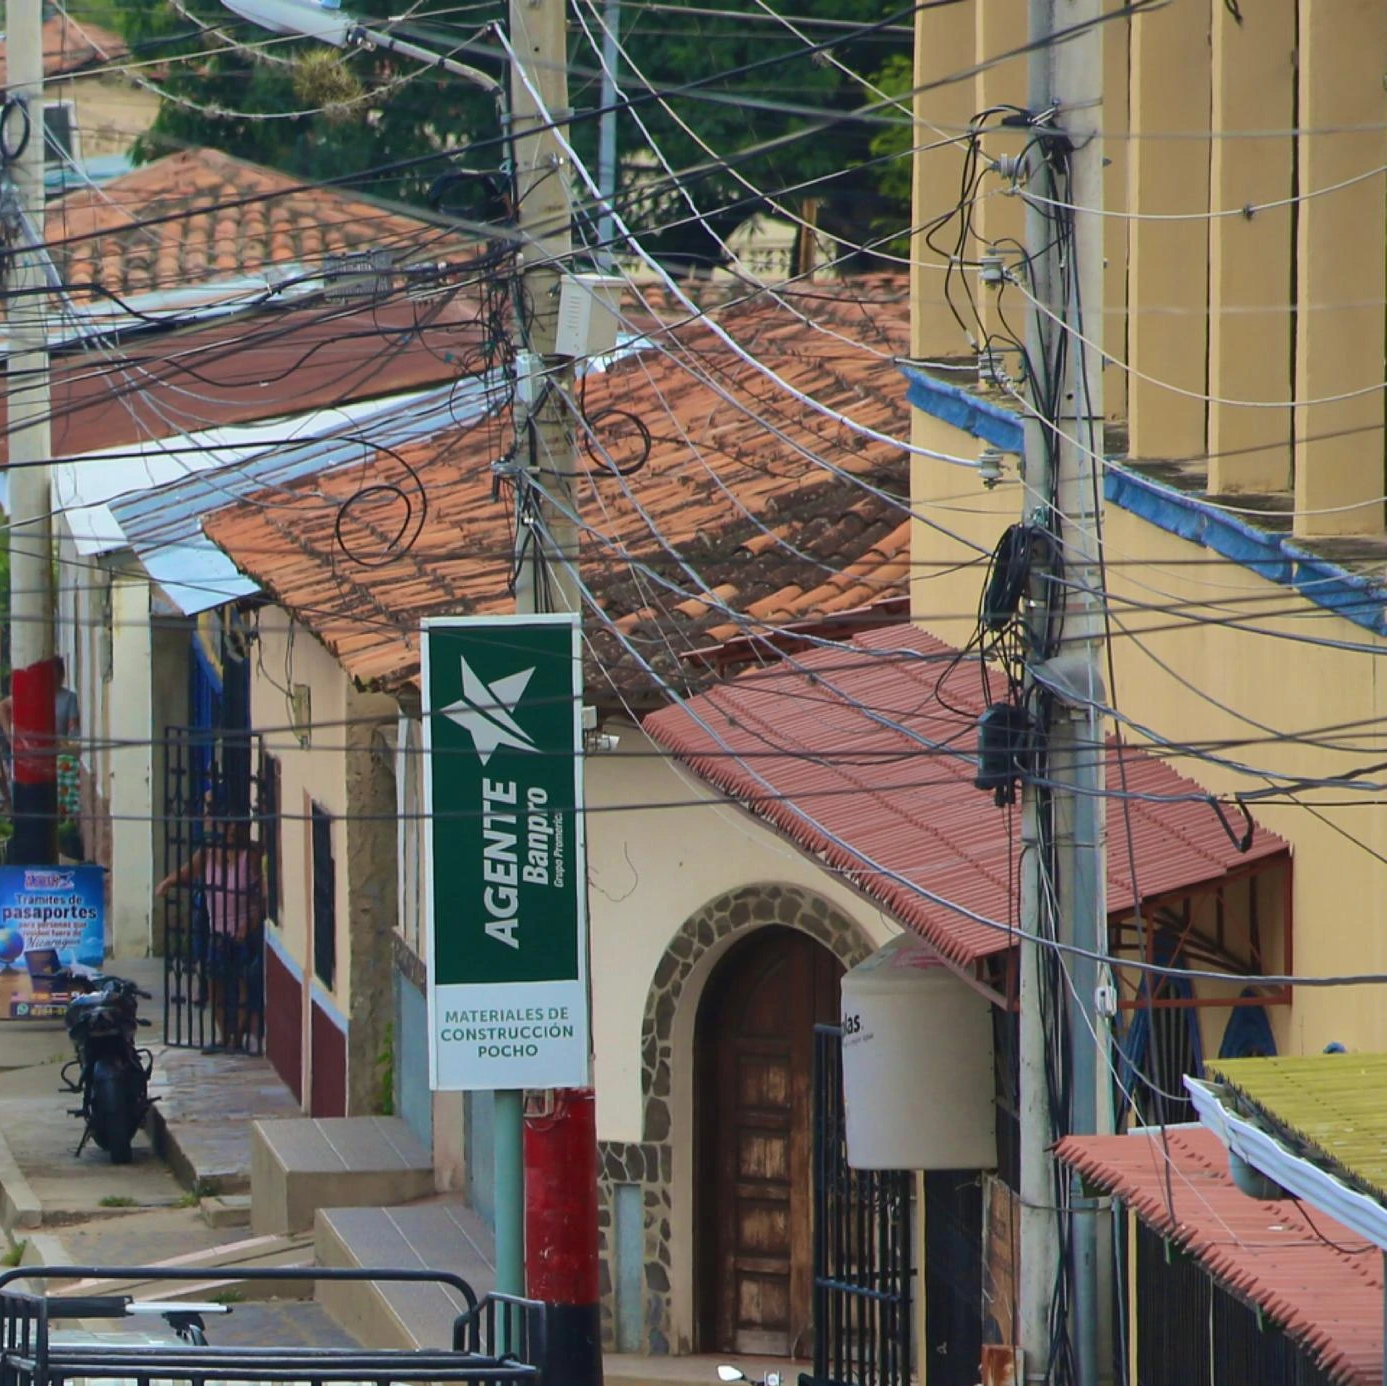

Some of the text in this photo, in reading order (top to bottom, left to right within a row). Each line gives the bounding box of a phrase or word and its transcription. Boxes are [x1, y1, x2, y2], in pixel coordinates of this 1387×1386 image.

[483, 778, 519, 949] AGENTE
[68, 894, 83, 905] de
[2, 906, 97, 921] pasaportes
[444, 1006, 570, 1025] MATERIALES DE
[440, 1022, 574, 1042] CONSTRUCCIÓN
[477, 1043, 539, 1059] POCHO
